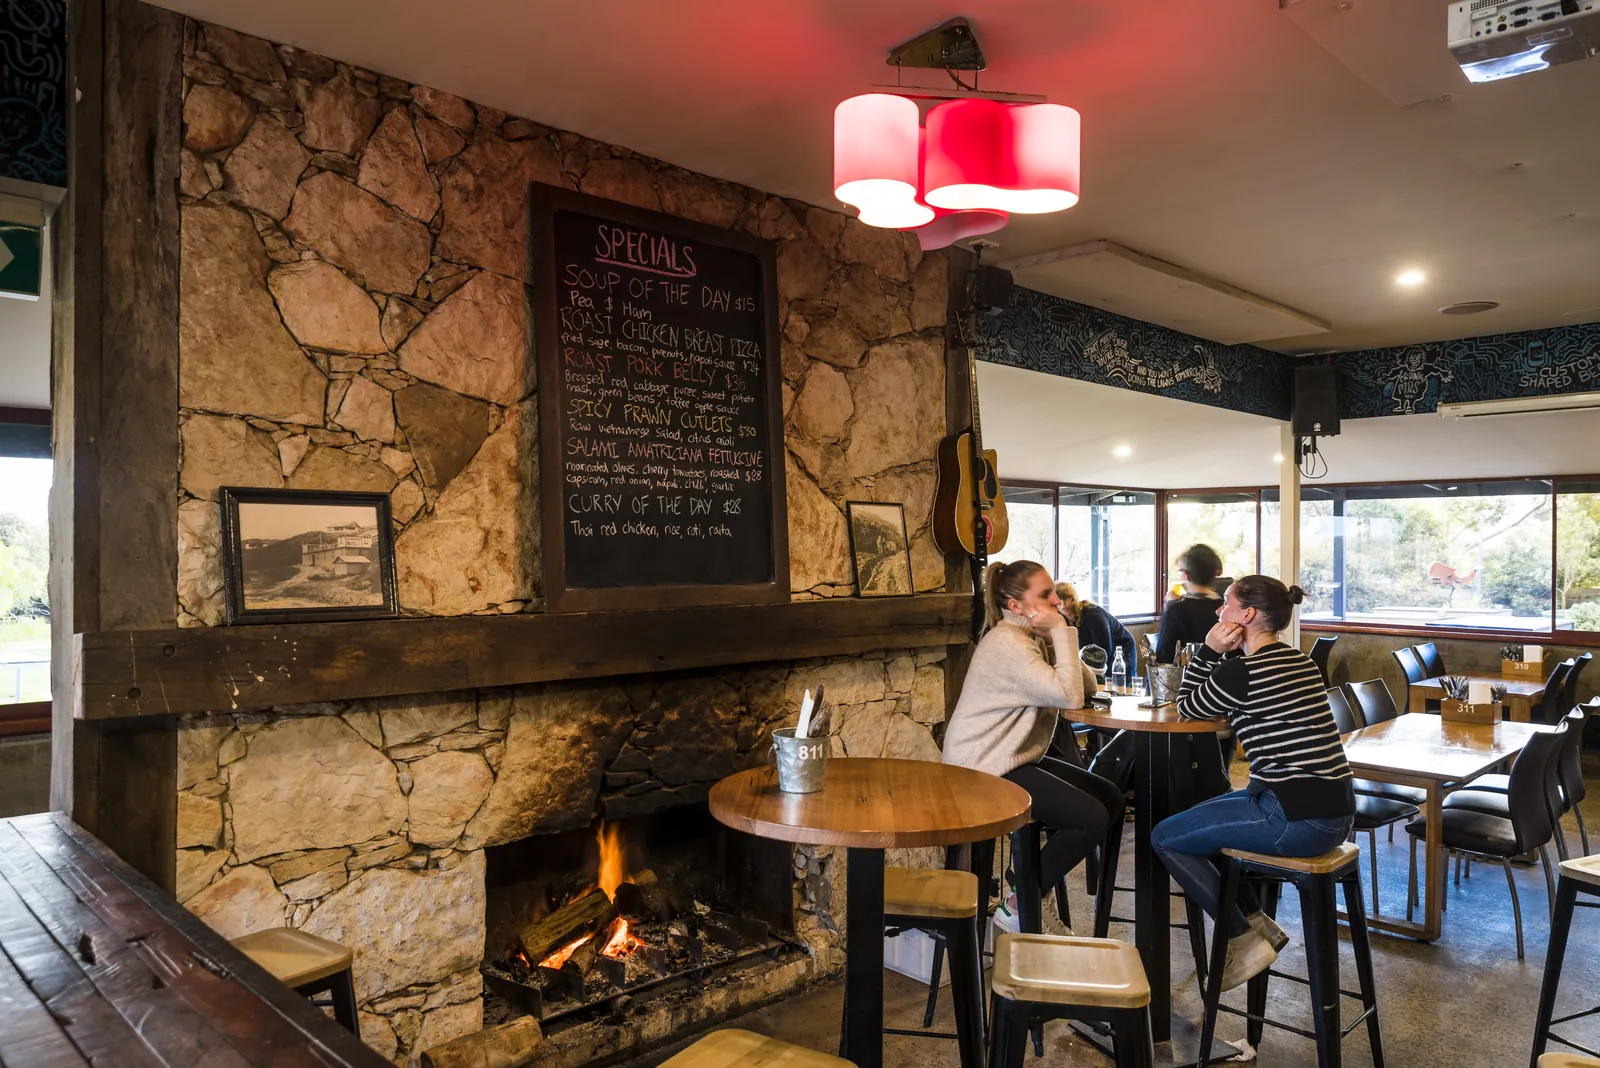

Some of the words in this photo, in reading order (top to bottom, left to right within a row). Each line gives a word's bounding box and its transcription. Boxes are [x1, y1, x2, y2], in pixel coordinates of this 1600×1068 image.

[595, 225, 697, 275] SPECIALS
[564, 264, 621, 293] SOUP
[629, 278, 653, 299] OF
[659, 281, 691, 305] THE
[701, 286, 731, 312] DAY
[735, 297, 756, 312] $15
[570, 290, 595, 310] Pea
[622, 301, 652, 321] Ham
[560, 306, 614, 335] ROAST
[622, 320, 680, 348] CHICKEN
[684, 327, 725, 356] BREAST
[730, 338, 762, 359] PIZZA
[561, 332, 584, 345] fried
[1083, 340, 1100, 358] START
[1099, 329, 1118, 346] MAKING
[1114, 347, 1130, 362] GOING
[1540, 351, 1600, 378] CUSTOM
[564, 347, 613, 373] ROAST
[627, 354, 664, 377] PORK
[673, 362, 716, 386] BELLY
[1106, 357, 1121, 372] HOME
[1122, 357, 1135, 373] LATE
[1137, 362, 1148, 376] AND
[1147, 367, 1157, 379] YOU
[1519, 376, 1572, 388] SHAPED
[1578, 362, 1600, 383] BE
[565, 369, 605, 385] Braised
[611, 377, 629, 390] red
[633, 380, 670, 397] cabbage
[1127, 373, 1147, 386] DOING
[1147, 377, 1157, 388] THE
[1157, 376, 1175, 388] LAWNS
[1398, 381, 1421, 395] MRS
[598, 388, 622, 402] green
[665, 396, 690, 409] toffee
[567, 398, 612, 418] SPICY
[624, 403, 672, 425] PRAWN
[681, 412, 733, 433] CUTLETS
[738, 424, 757, 438] $30
[569, 418, 592, 431] Raw
[687, 432, 712, 444] citrus
[567, 437, 620, 459] SALAMI
[611, 475, 626, 484] red
[629, 477, 653, 490] onion,
[745, 469, 762, 483] $28
[569, 494, 623, 514] CURRY
[631, 494, 650, 515] OF
[657, 496, 683, 515] THE
[690, 497, 713, 515] DAY
[570, 520, 594, 537] Thai
[600, 521, 618, 536] red
[622, 520, 660, 538] chicken,
[664, 523, 683, 538] rice,
[687, 523, 706, 539] roti,
[709, 523, 733, 537] raita
[1514, 662, 1529, 670] 310
[1457, 703, 1475, 714] 311
[798, 743, 823, 760] 811
